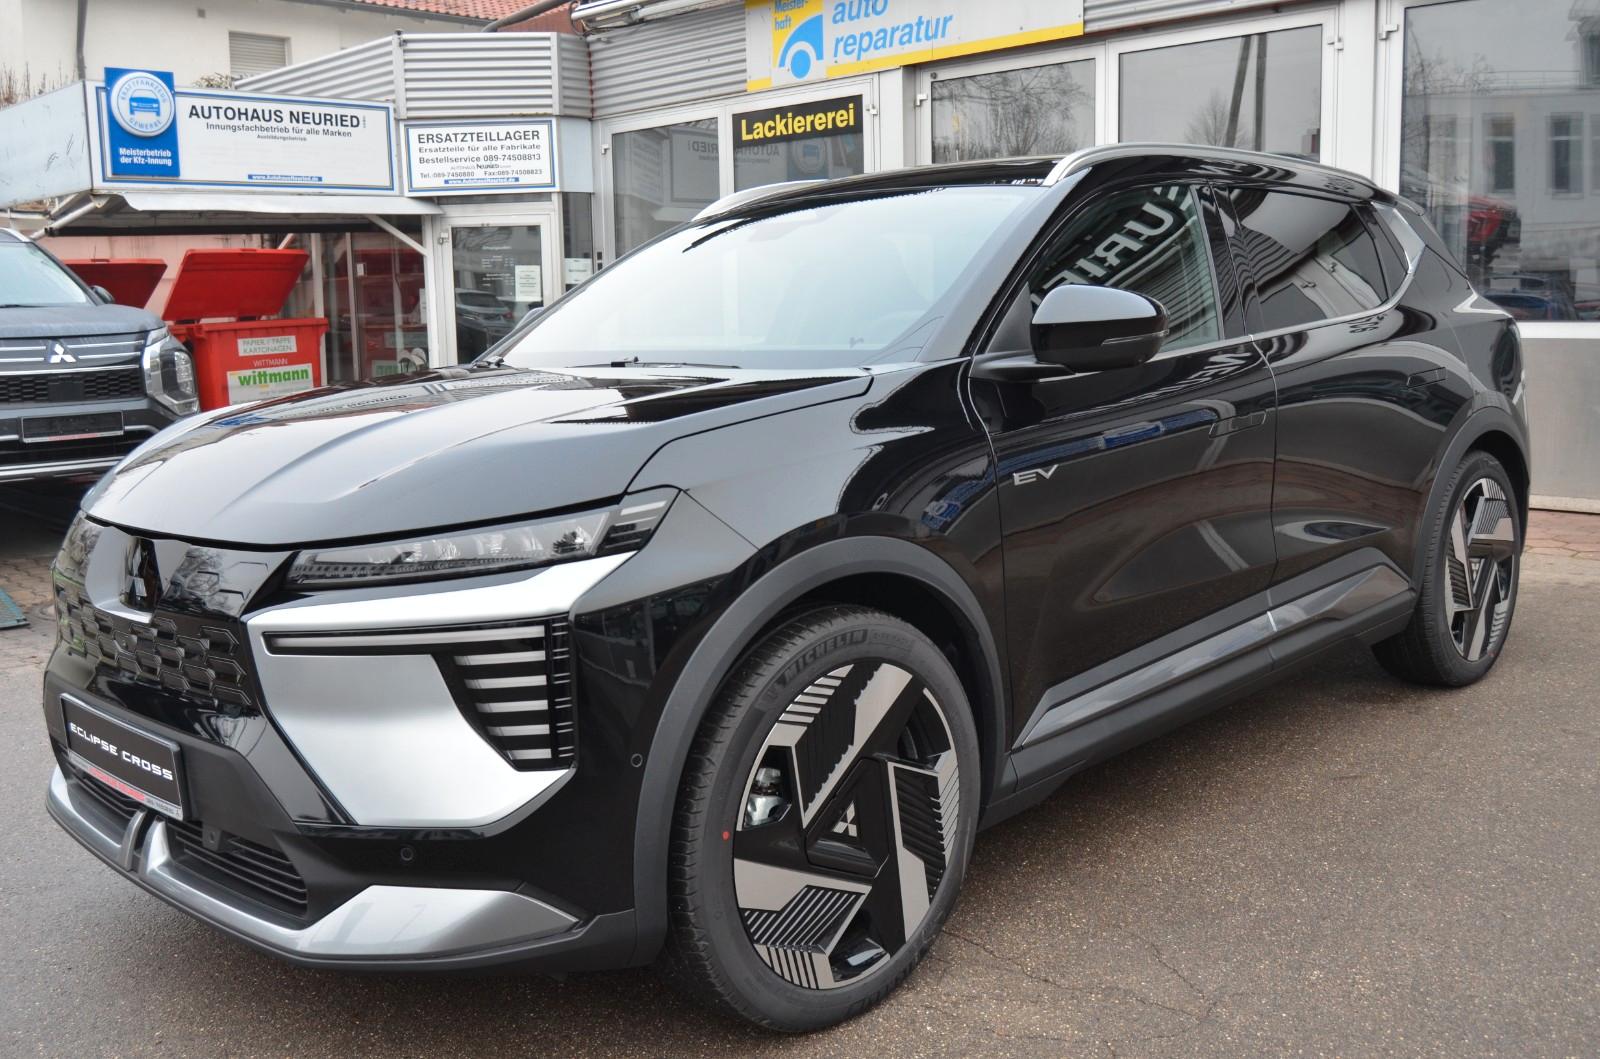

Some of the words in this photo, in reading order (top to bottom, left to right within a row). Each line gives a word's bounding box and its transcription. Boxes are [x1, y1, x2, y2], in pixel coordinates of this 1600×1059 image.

[832, 0, 888, 25] auto
[775, 17, 792, 31] haft
[834, 15, 953, 61] reparatur
[189, 105, 283, 123] AUTOHAUS
[289, 110, 360, 128] NEURIED
[741, 103, 855, 141] Lackiererei
[206, 122, 290, 133] Innungsfachbetrieb
[292, 126, 303, 135] für
[305, 128, 320, 136] alle
[322, 128, 352, 138] Marken
[418, 130, 540, 144] ERSATZTEILLAGER
[119, 147, 171, 157] Meisterbetrieb
[500, 143, 541, 151] Fabrikate
[120, 156, 132, 164] der
[133, 157, 172, 166] Kfz-Innung
[419, 155, 481, 164] Bestellservice
[483, 153, 541, 162] 089-74508813
[253, 358, 288, 368] WITTMANN
[238, 368, 309, 386] wittmann
[1013, 464, 1059, 486] EV
[783, 629, 869, 682] MICHELIN
[69, 722, 119, 756] ECLIPSE
[121, 750, 173, 781] CROSS
